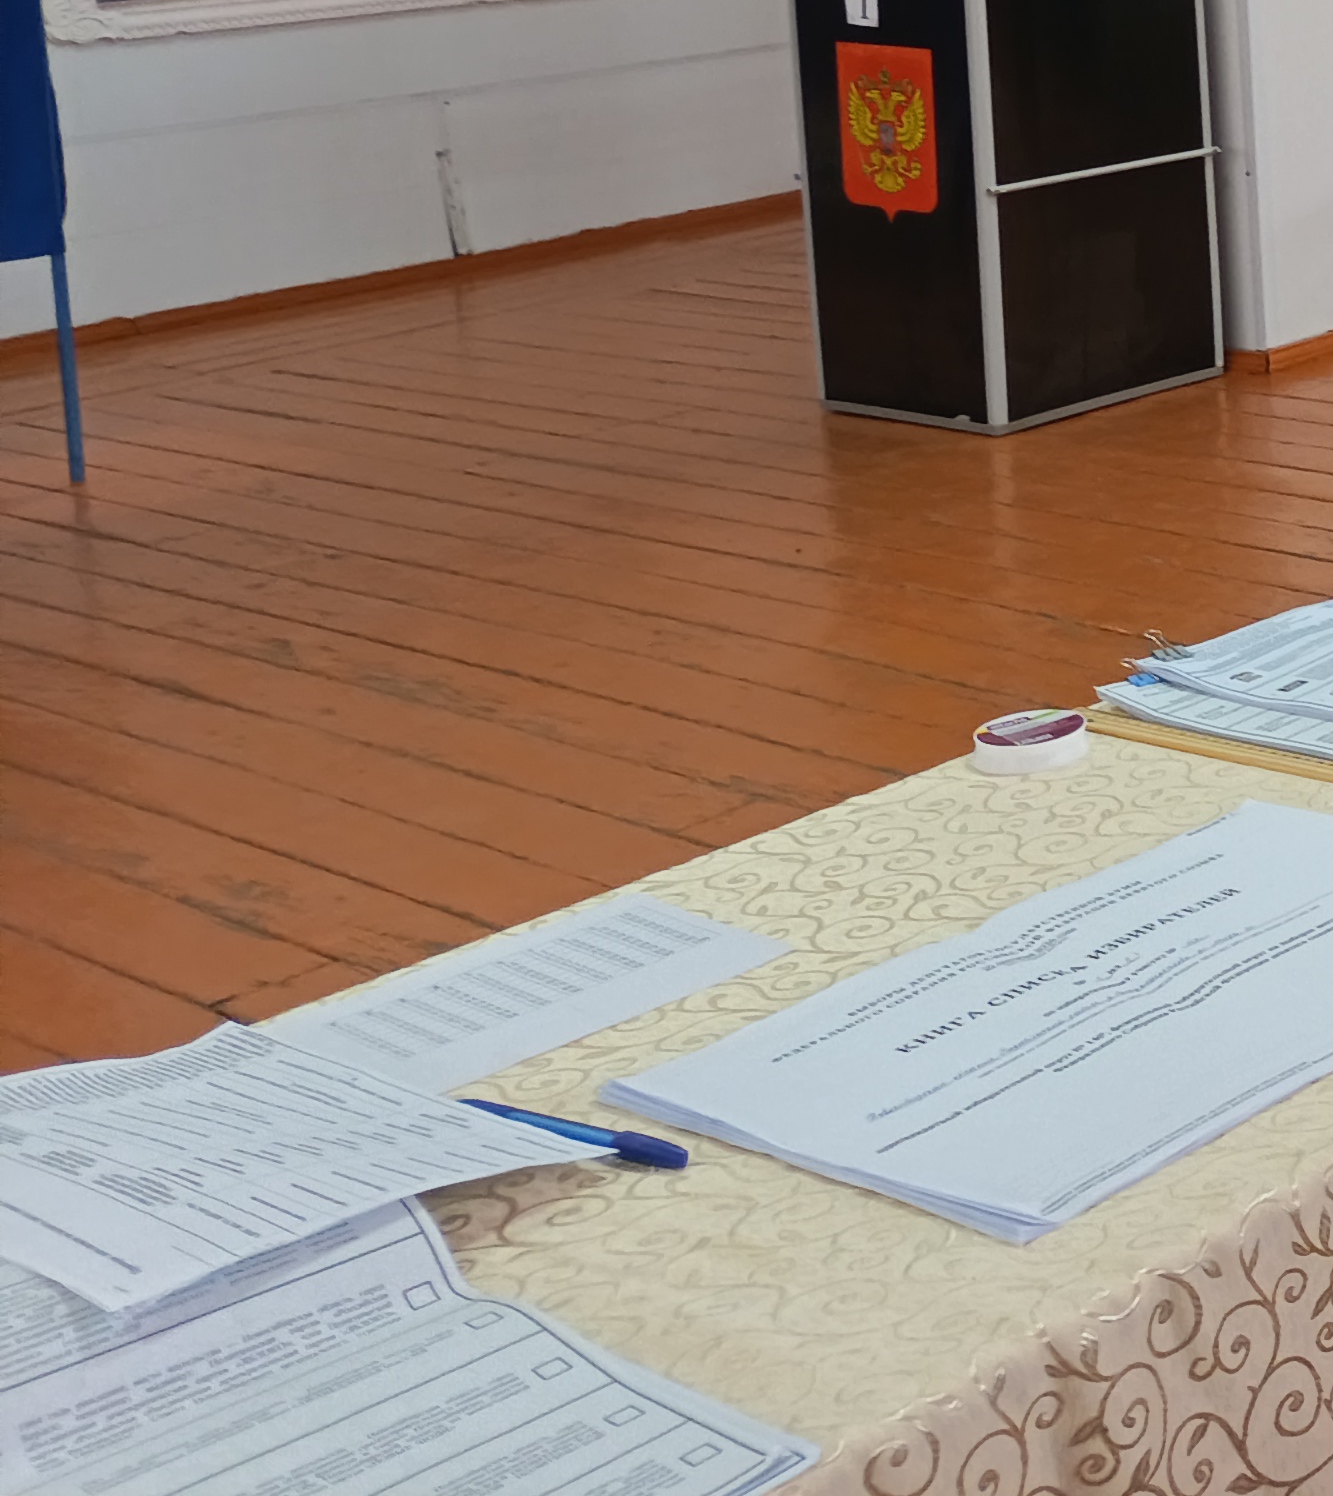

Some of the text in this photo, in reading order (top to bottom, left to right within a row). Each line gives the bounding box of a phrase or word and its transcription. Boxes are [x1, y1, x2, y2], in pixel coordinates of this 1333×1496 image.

[894, 1010, 986, 1053] КНИГА
[986, 965, 1088, 1007] СПИСКА
[1085, 888, 1240, 960] ИЗБИРАТЕЛЕЙ
